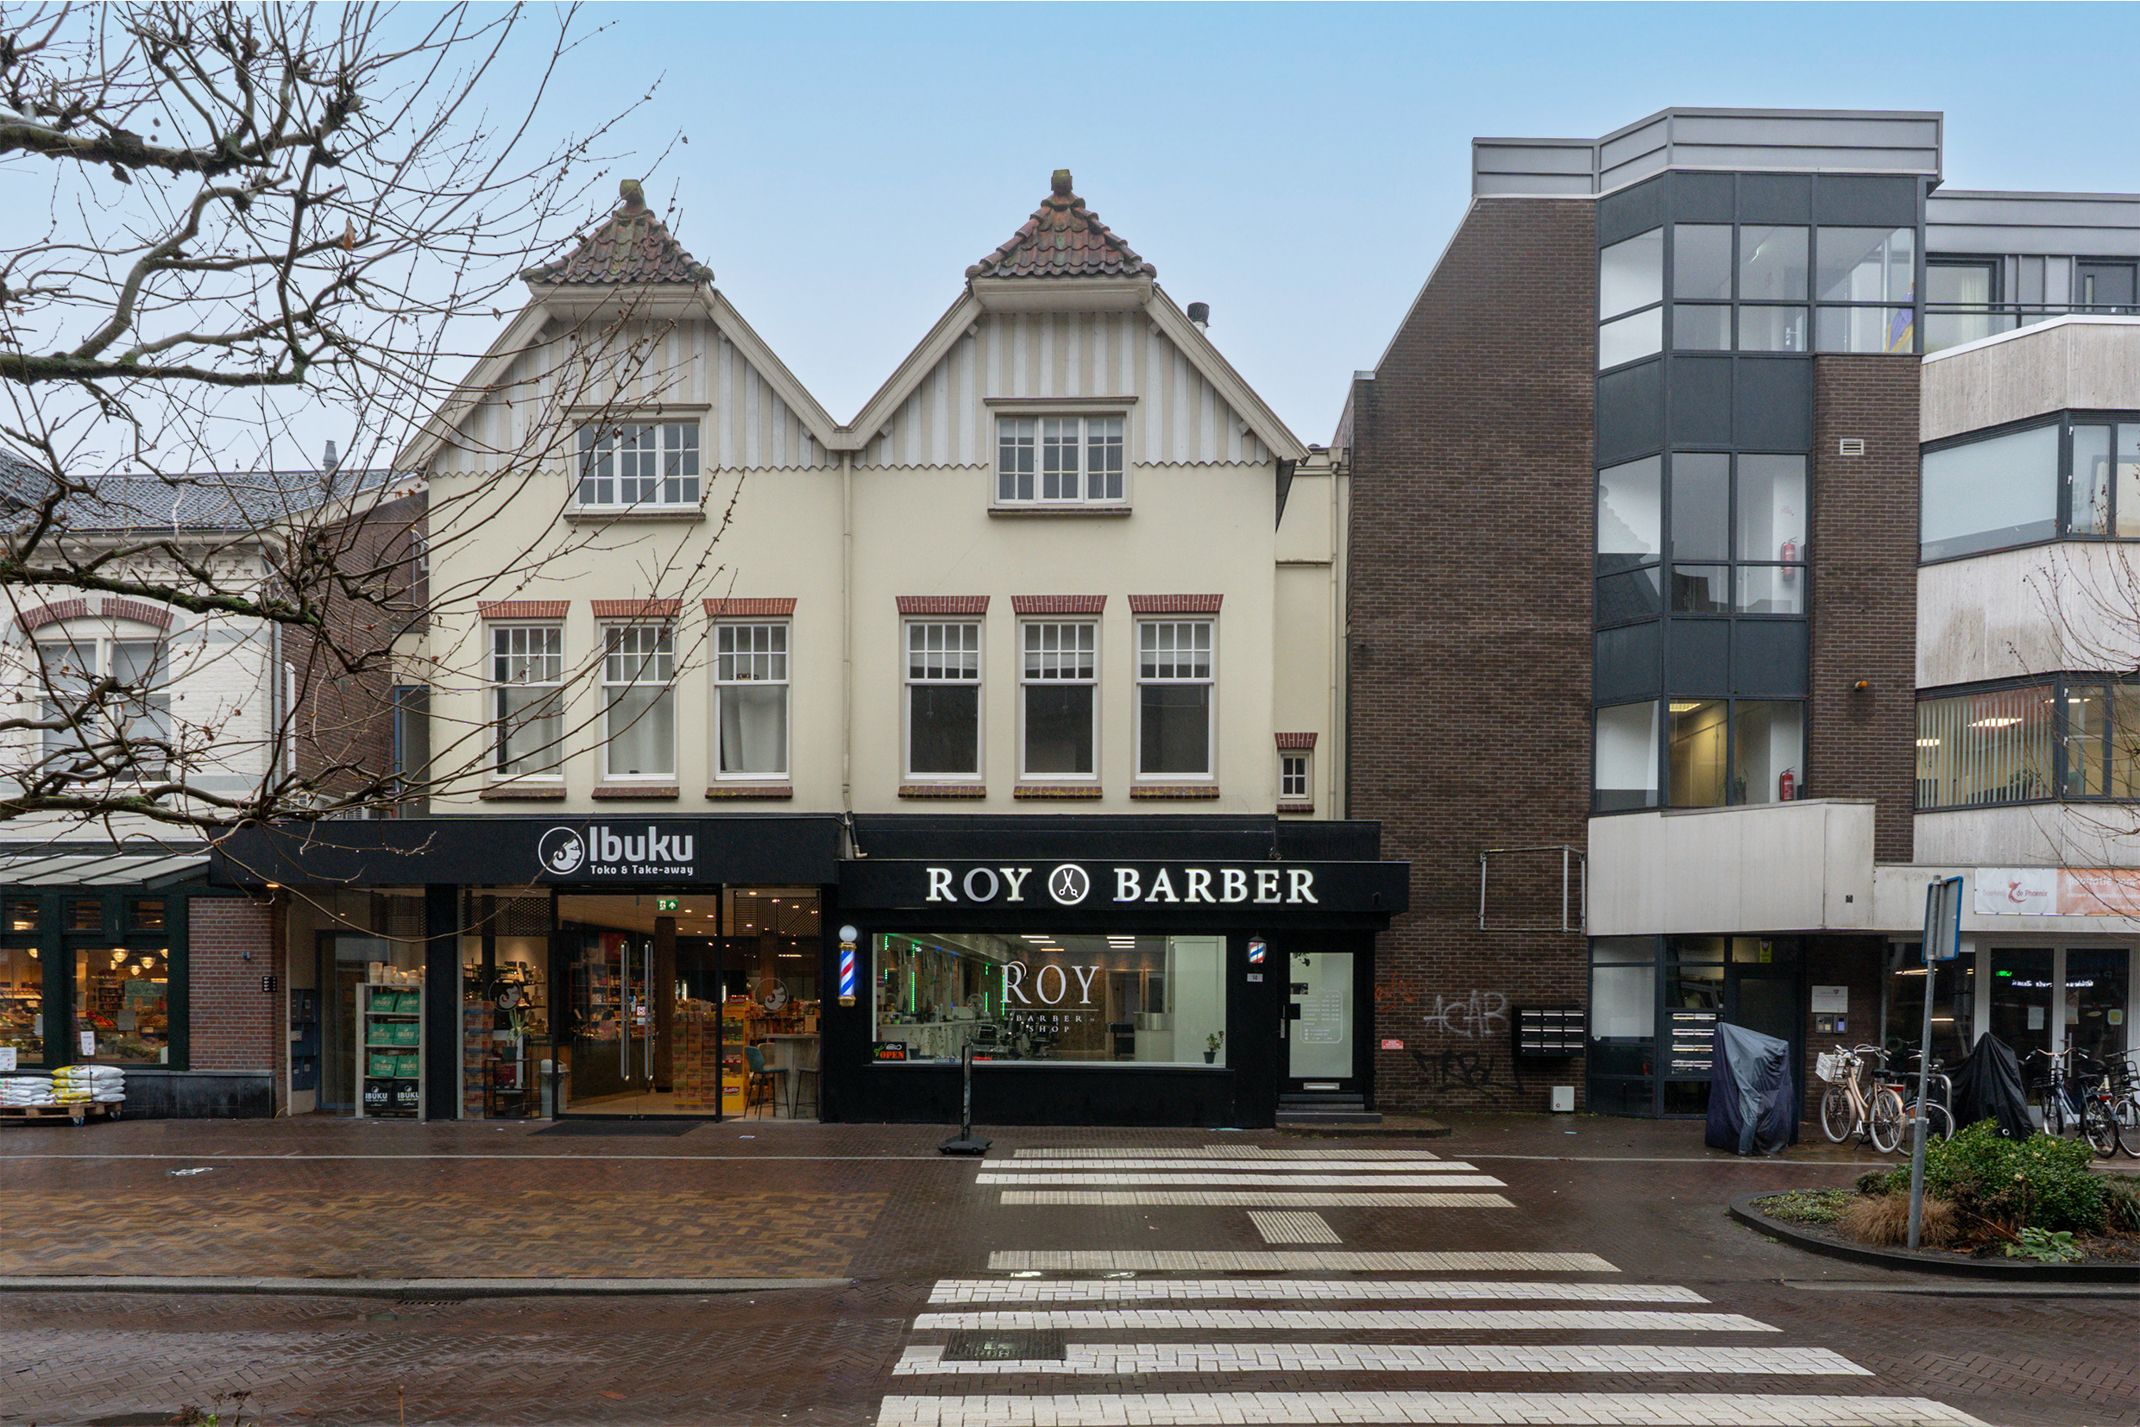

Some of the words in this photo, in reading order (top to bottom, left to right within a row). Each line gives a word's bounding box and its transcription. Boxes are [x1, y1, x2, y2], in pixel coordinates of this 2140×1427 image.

[590, 826, 693, 862] Ibuku
[591, 865, 617, 875] Toko
[621, 865, 628, 875] &
[632, 865, 694, 876] Take-away
[926, 868, 1033, 903] ROY
[1113, 868, 1319, 904] BARBER
[1000, 964, 1100, 1005] ROY
[1016, 1015, 1083, 1023] BARBER
[879, 1050, 905, 1060] OPEN
